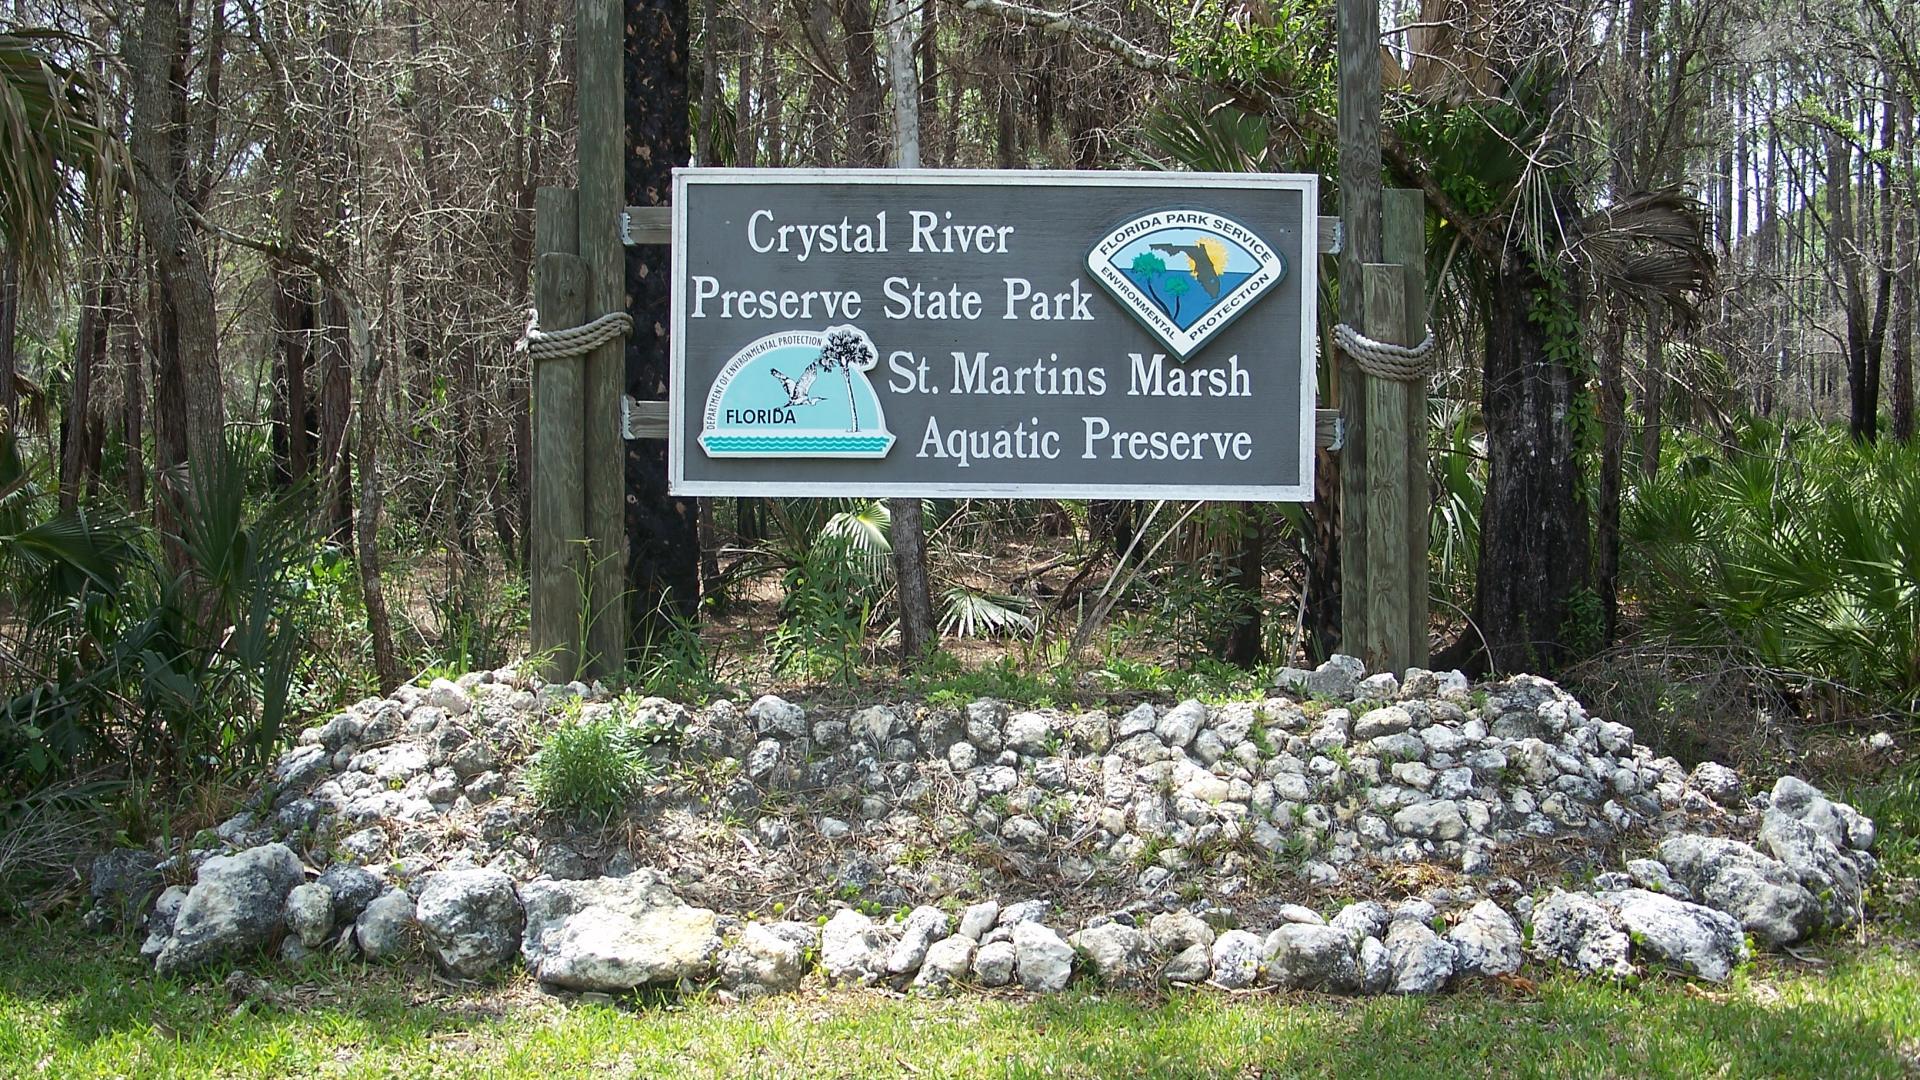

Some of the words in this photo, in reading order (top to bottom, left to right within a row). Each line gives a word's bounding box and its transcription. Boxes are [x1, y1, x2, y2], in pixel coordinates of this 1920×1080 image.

[747, 209, 889, 262] Crystal
[908, 210, 1015, 254] River
[1099, 217, 1162, 256] FLORIDA
[1166, 213, 1209, 226] PARK
[1212, 218, 1273, 263] SERVICE
[690, 275, 862, 320] Preserve
[883, 276, 982, 320] State
[1002, 277, 1095, 321] Park
[1101, 266, 1175, 340] ENVIRONMENTAL
[1189, 273, 1270, 341] PROTECTION
[706, 385, 726, 430] DEPARTMENT
[719, 375, 730, 386] OF
[725, 338, 778, 378] ENVIRONMENTAL
[778, 335, 823, 347] PROTECTION
[888, 350, 939, 395] St.
[950, 351, 1107, 396] Martins
[1127, 352, 1252, 397] Marsh
[726, 409, 797, 425] FLORIDA
[915, 415, 1061, 468] Aquatic
[1081, 416, 1252, 461] Preserve
